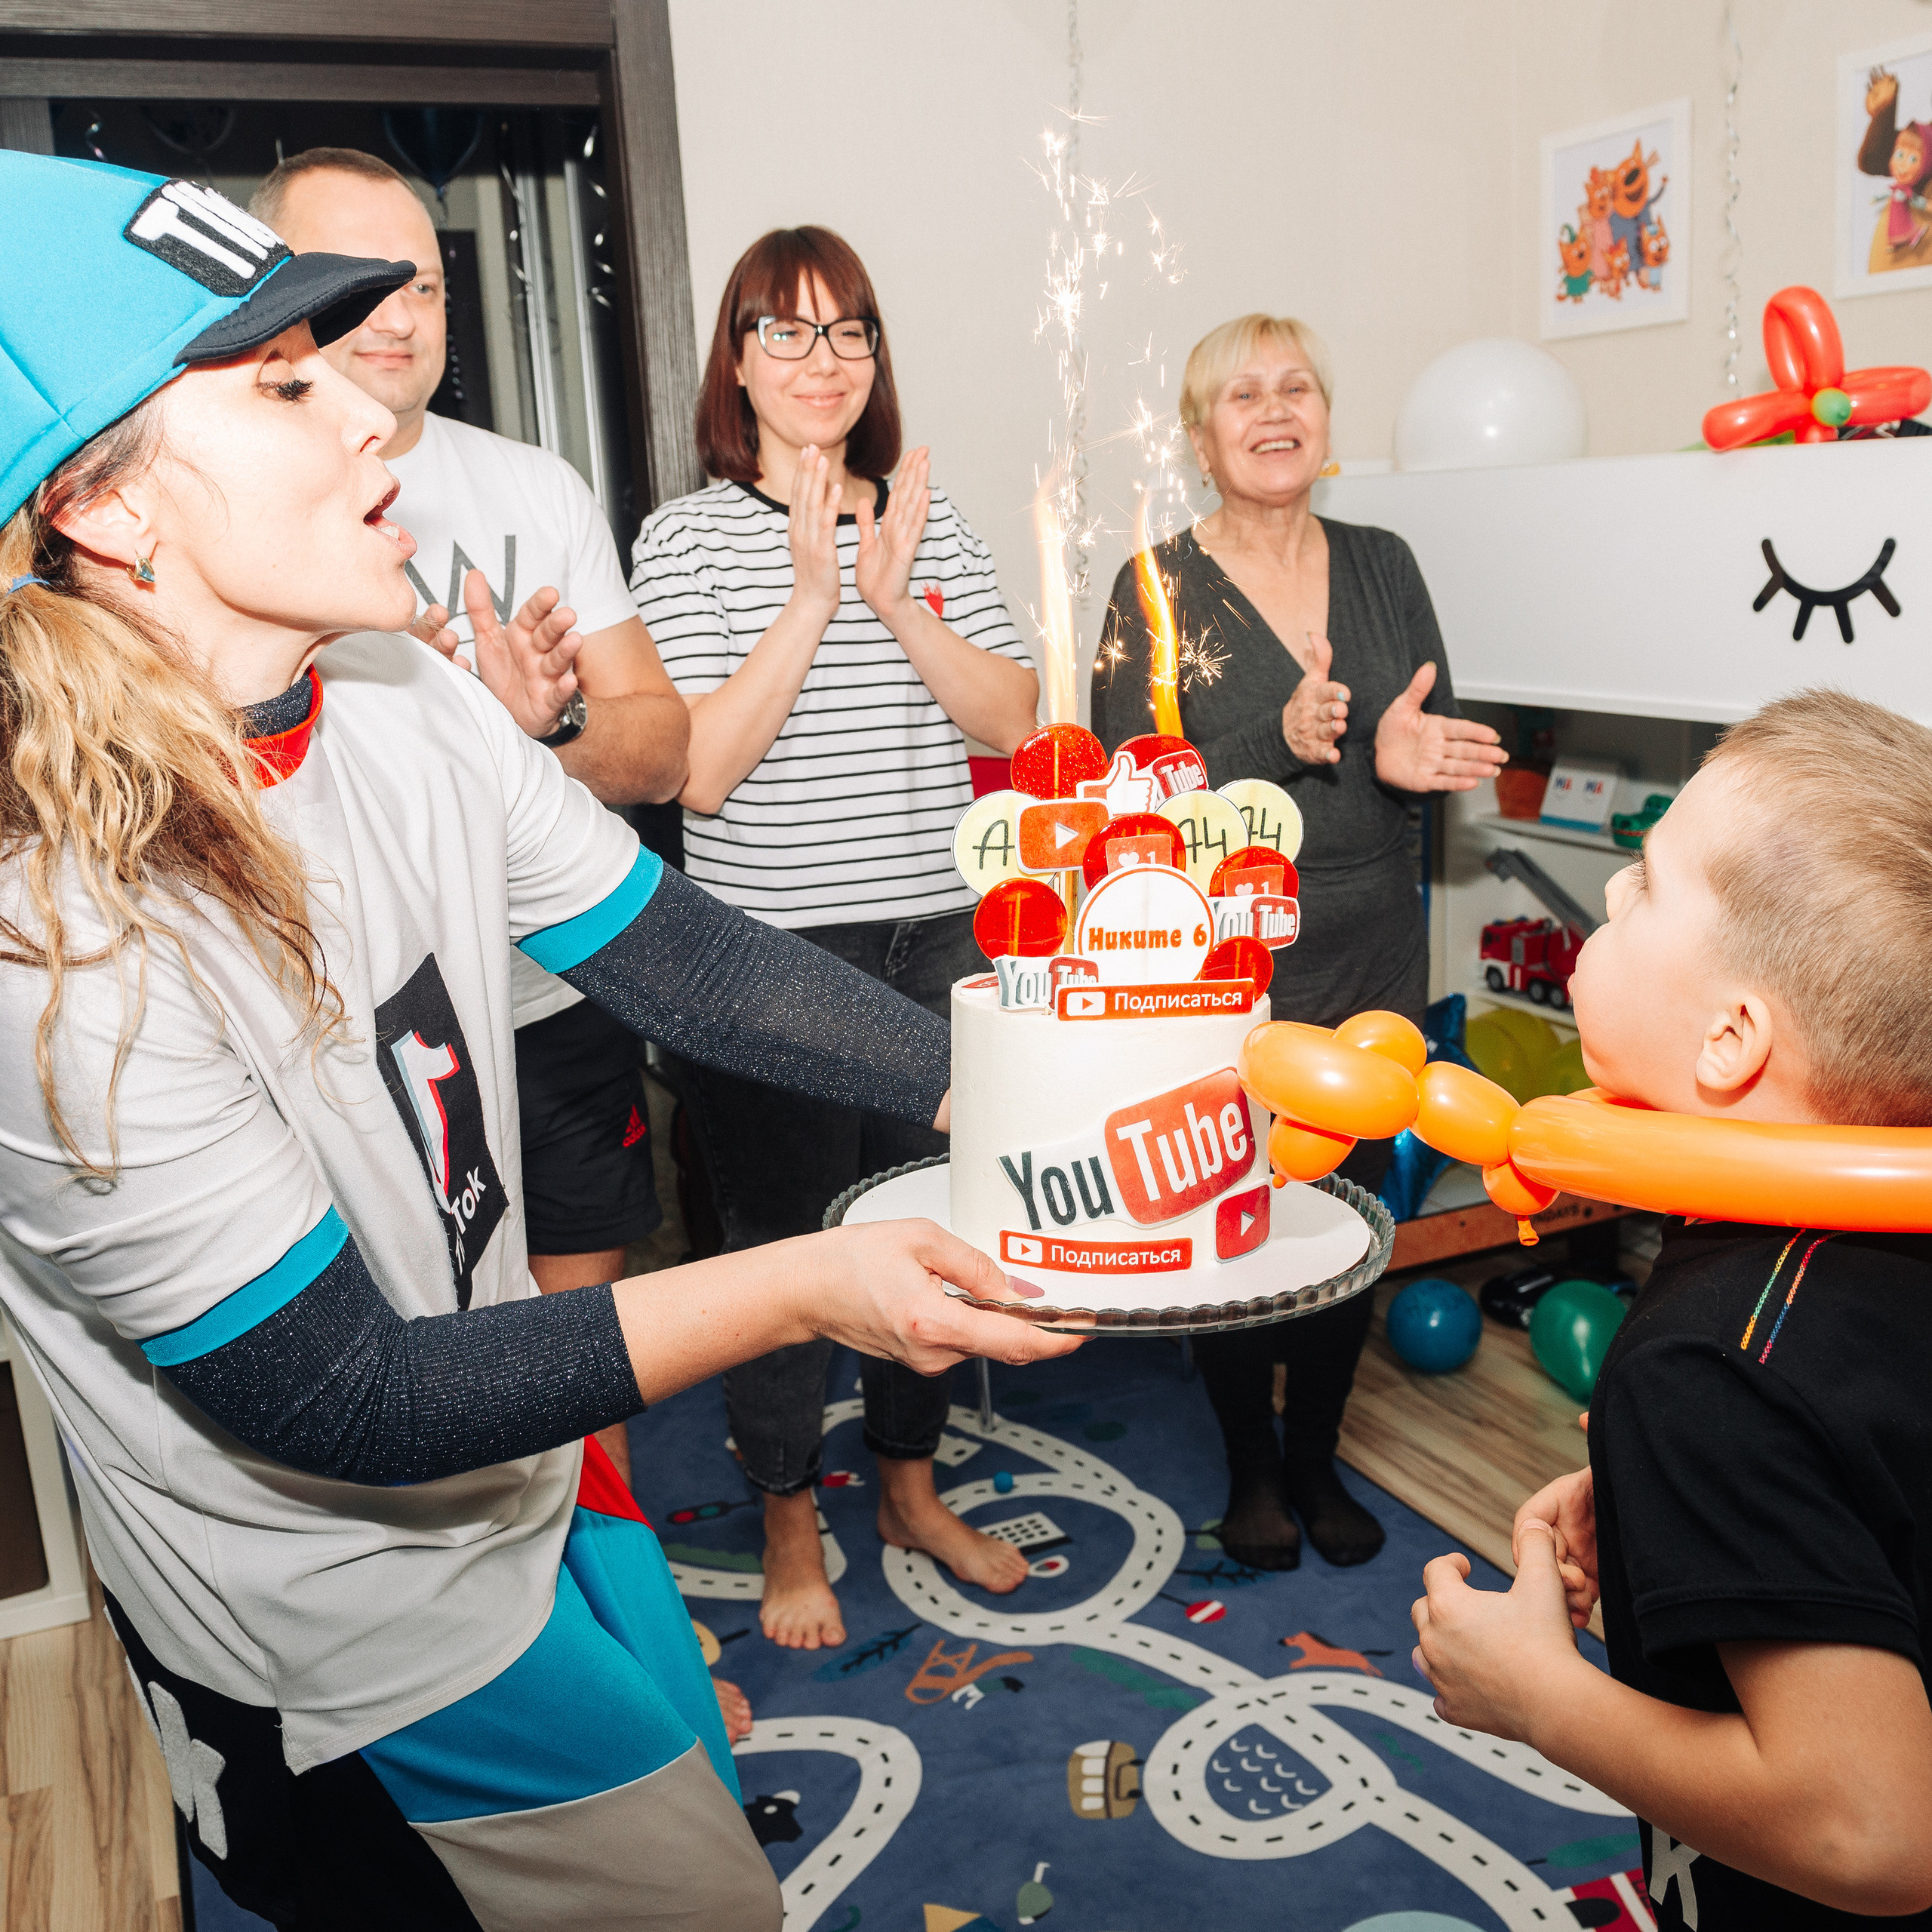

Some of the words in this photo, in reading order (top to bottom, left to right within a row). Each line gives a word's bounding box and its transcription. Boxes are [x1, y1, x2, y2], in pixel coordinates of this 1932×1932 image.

[972, 820, 1014, 870] A
[1088, 928, 1182, 951] Никите
[1193, 924, 1207, 946] 6
[1115, 991, 1242, 1013] Подписаться
[1051, 1245, 1180, 1268] Подписаться
